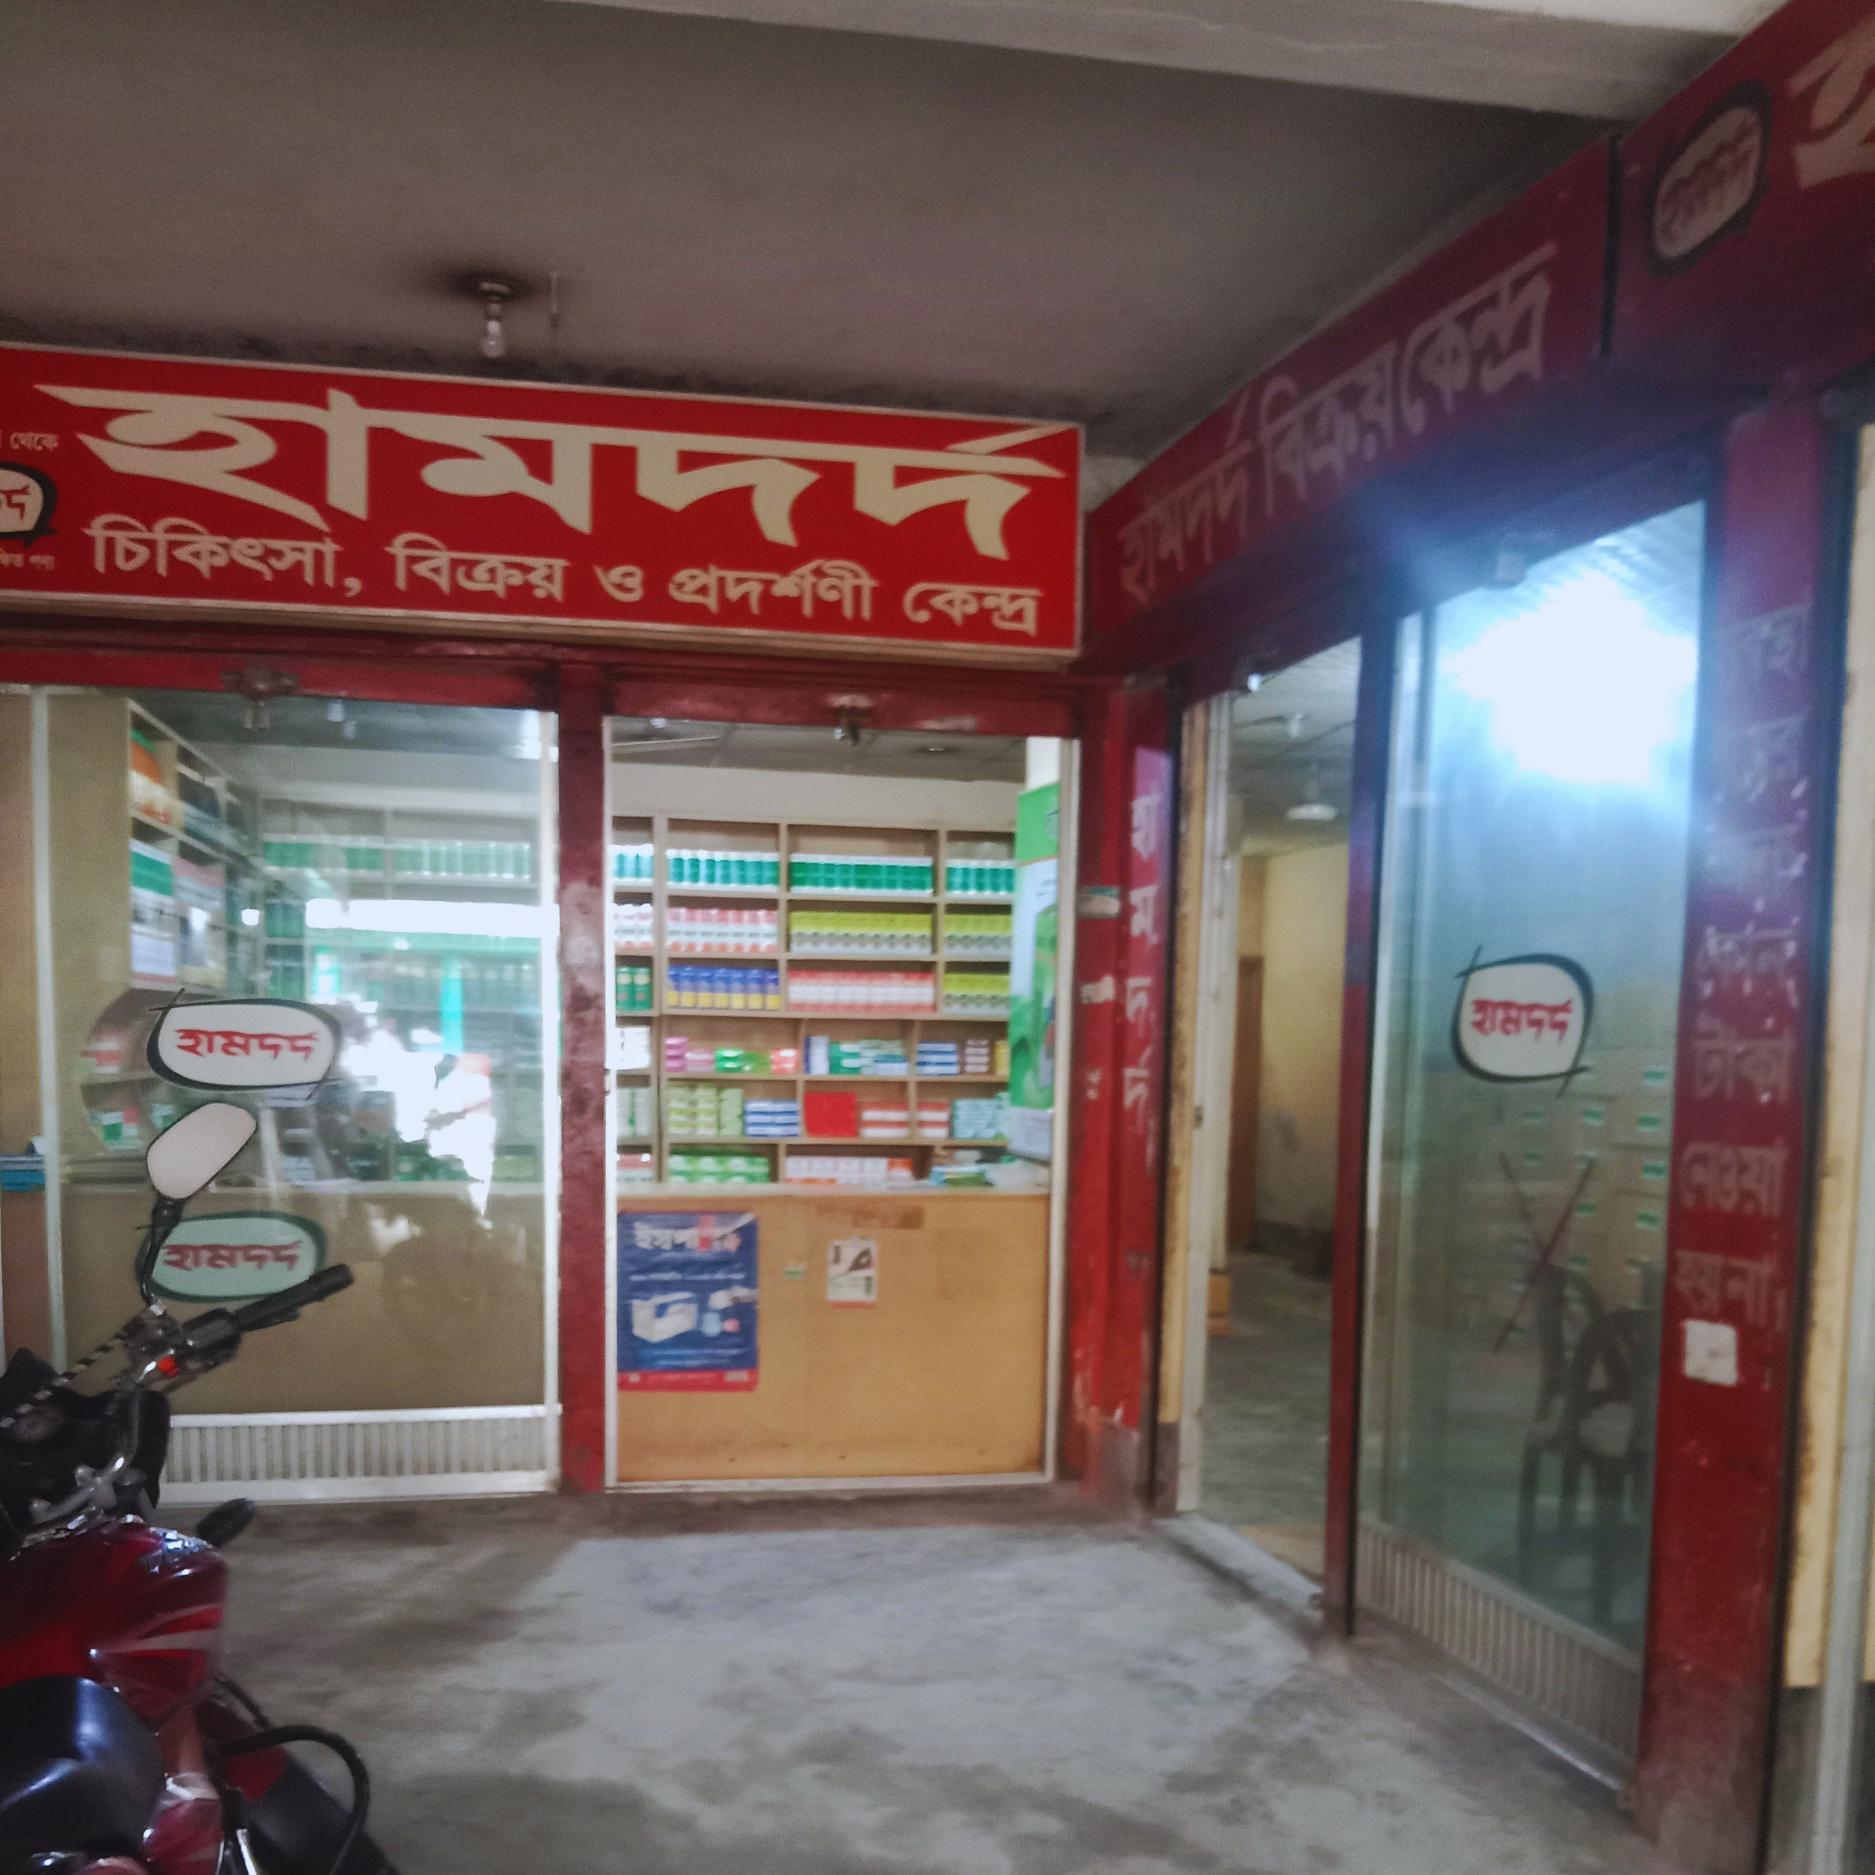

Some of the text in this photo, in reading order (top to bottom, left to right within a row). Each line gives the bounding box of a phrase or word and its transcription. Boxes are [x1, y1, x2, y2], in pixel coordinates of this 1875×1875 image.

[33, 385, 1075, 560] হামদর্দ
[82, 514, 362, 598] চিকিৎসা,
[384, 532, 569, 600] বিক্রয়
[594, 565, 644, 602] ও
[903, 581, 1043, 636] কেন্দ্র
[1472, 999, 1572, 1041] হামদর্দ
[175, 1028, 318, 1060] হামদর্দ
[161, 1241, 303, 1271] হামদর্দ
